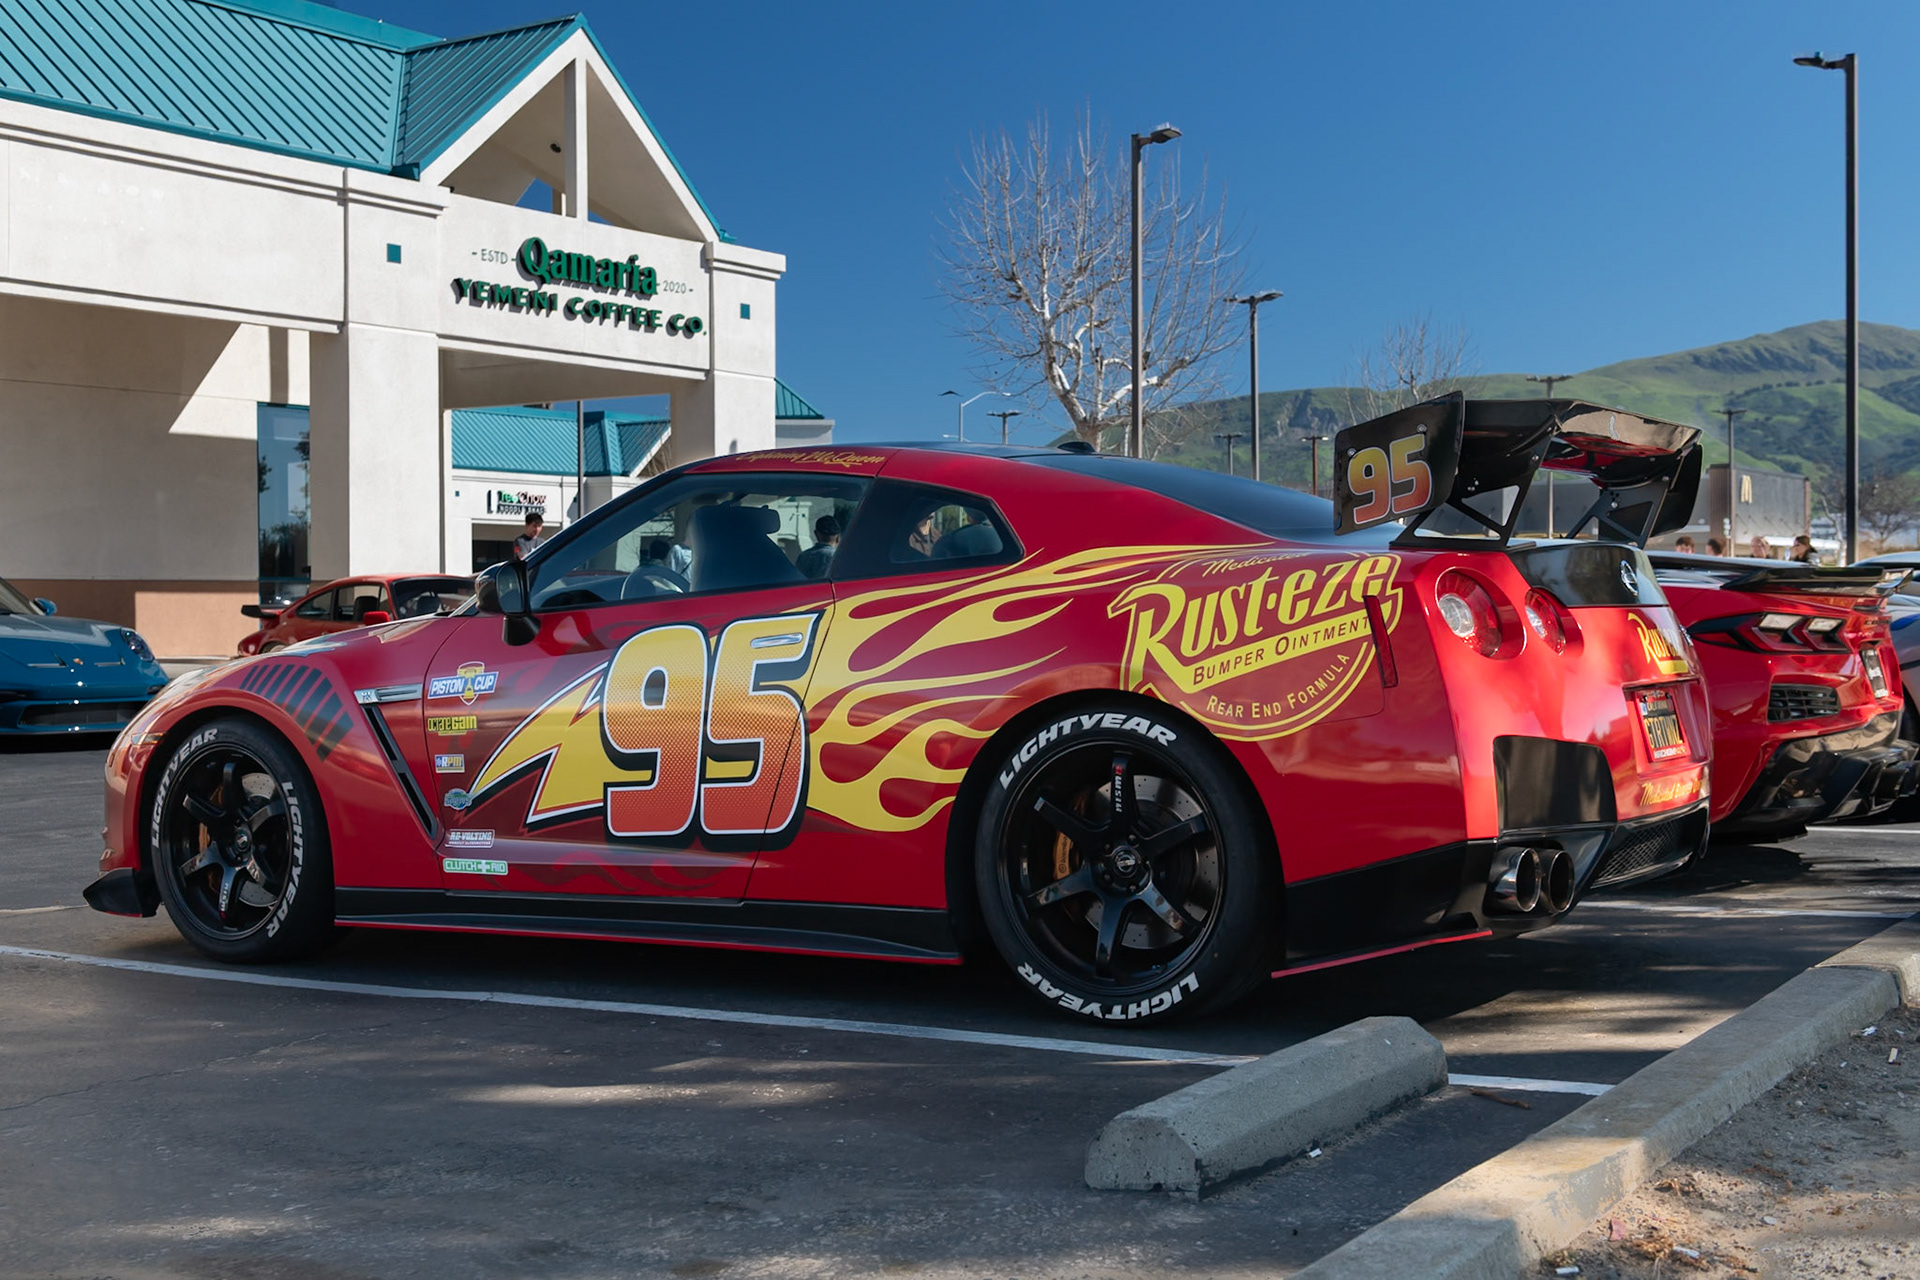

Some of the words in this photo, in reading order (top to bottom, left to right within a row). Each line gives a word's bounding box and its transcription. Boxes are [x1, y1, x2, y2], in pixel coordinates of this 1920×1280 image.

[481, 248, 508, 265] ESTD
[518, 236, 658, 295] Qamaria
[453, 277, 558, 312] YEMENI
[567, 296, 663, 329] COFFEE
[671, 313, 707, 336] CO.
[662, 280, 687, 294] 2020
[499, 505, 524, 513] NOODL
[1347, 434, 1432, 525] 95
[431, 679, 465, 695] PISTON
[474, 674, 495, 690] CUP
[603, 612, 820, 838] 95
[999, 712, 1178, 790] LIGHTYEAR
[151, 728, 218, 849] LIGHTYEAR
[266, 781, 304, 938] LIGHTYEAR
[1017, 961, 1201, 1020] LIGHTYEAR
